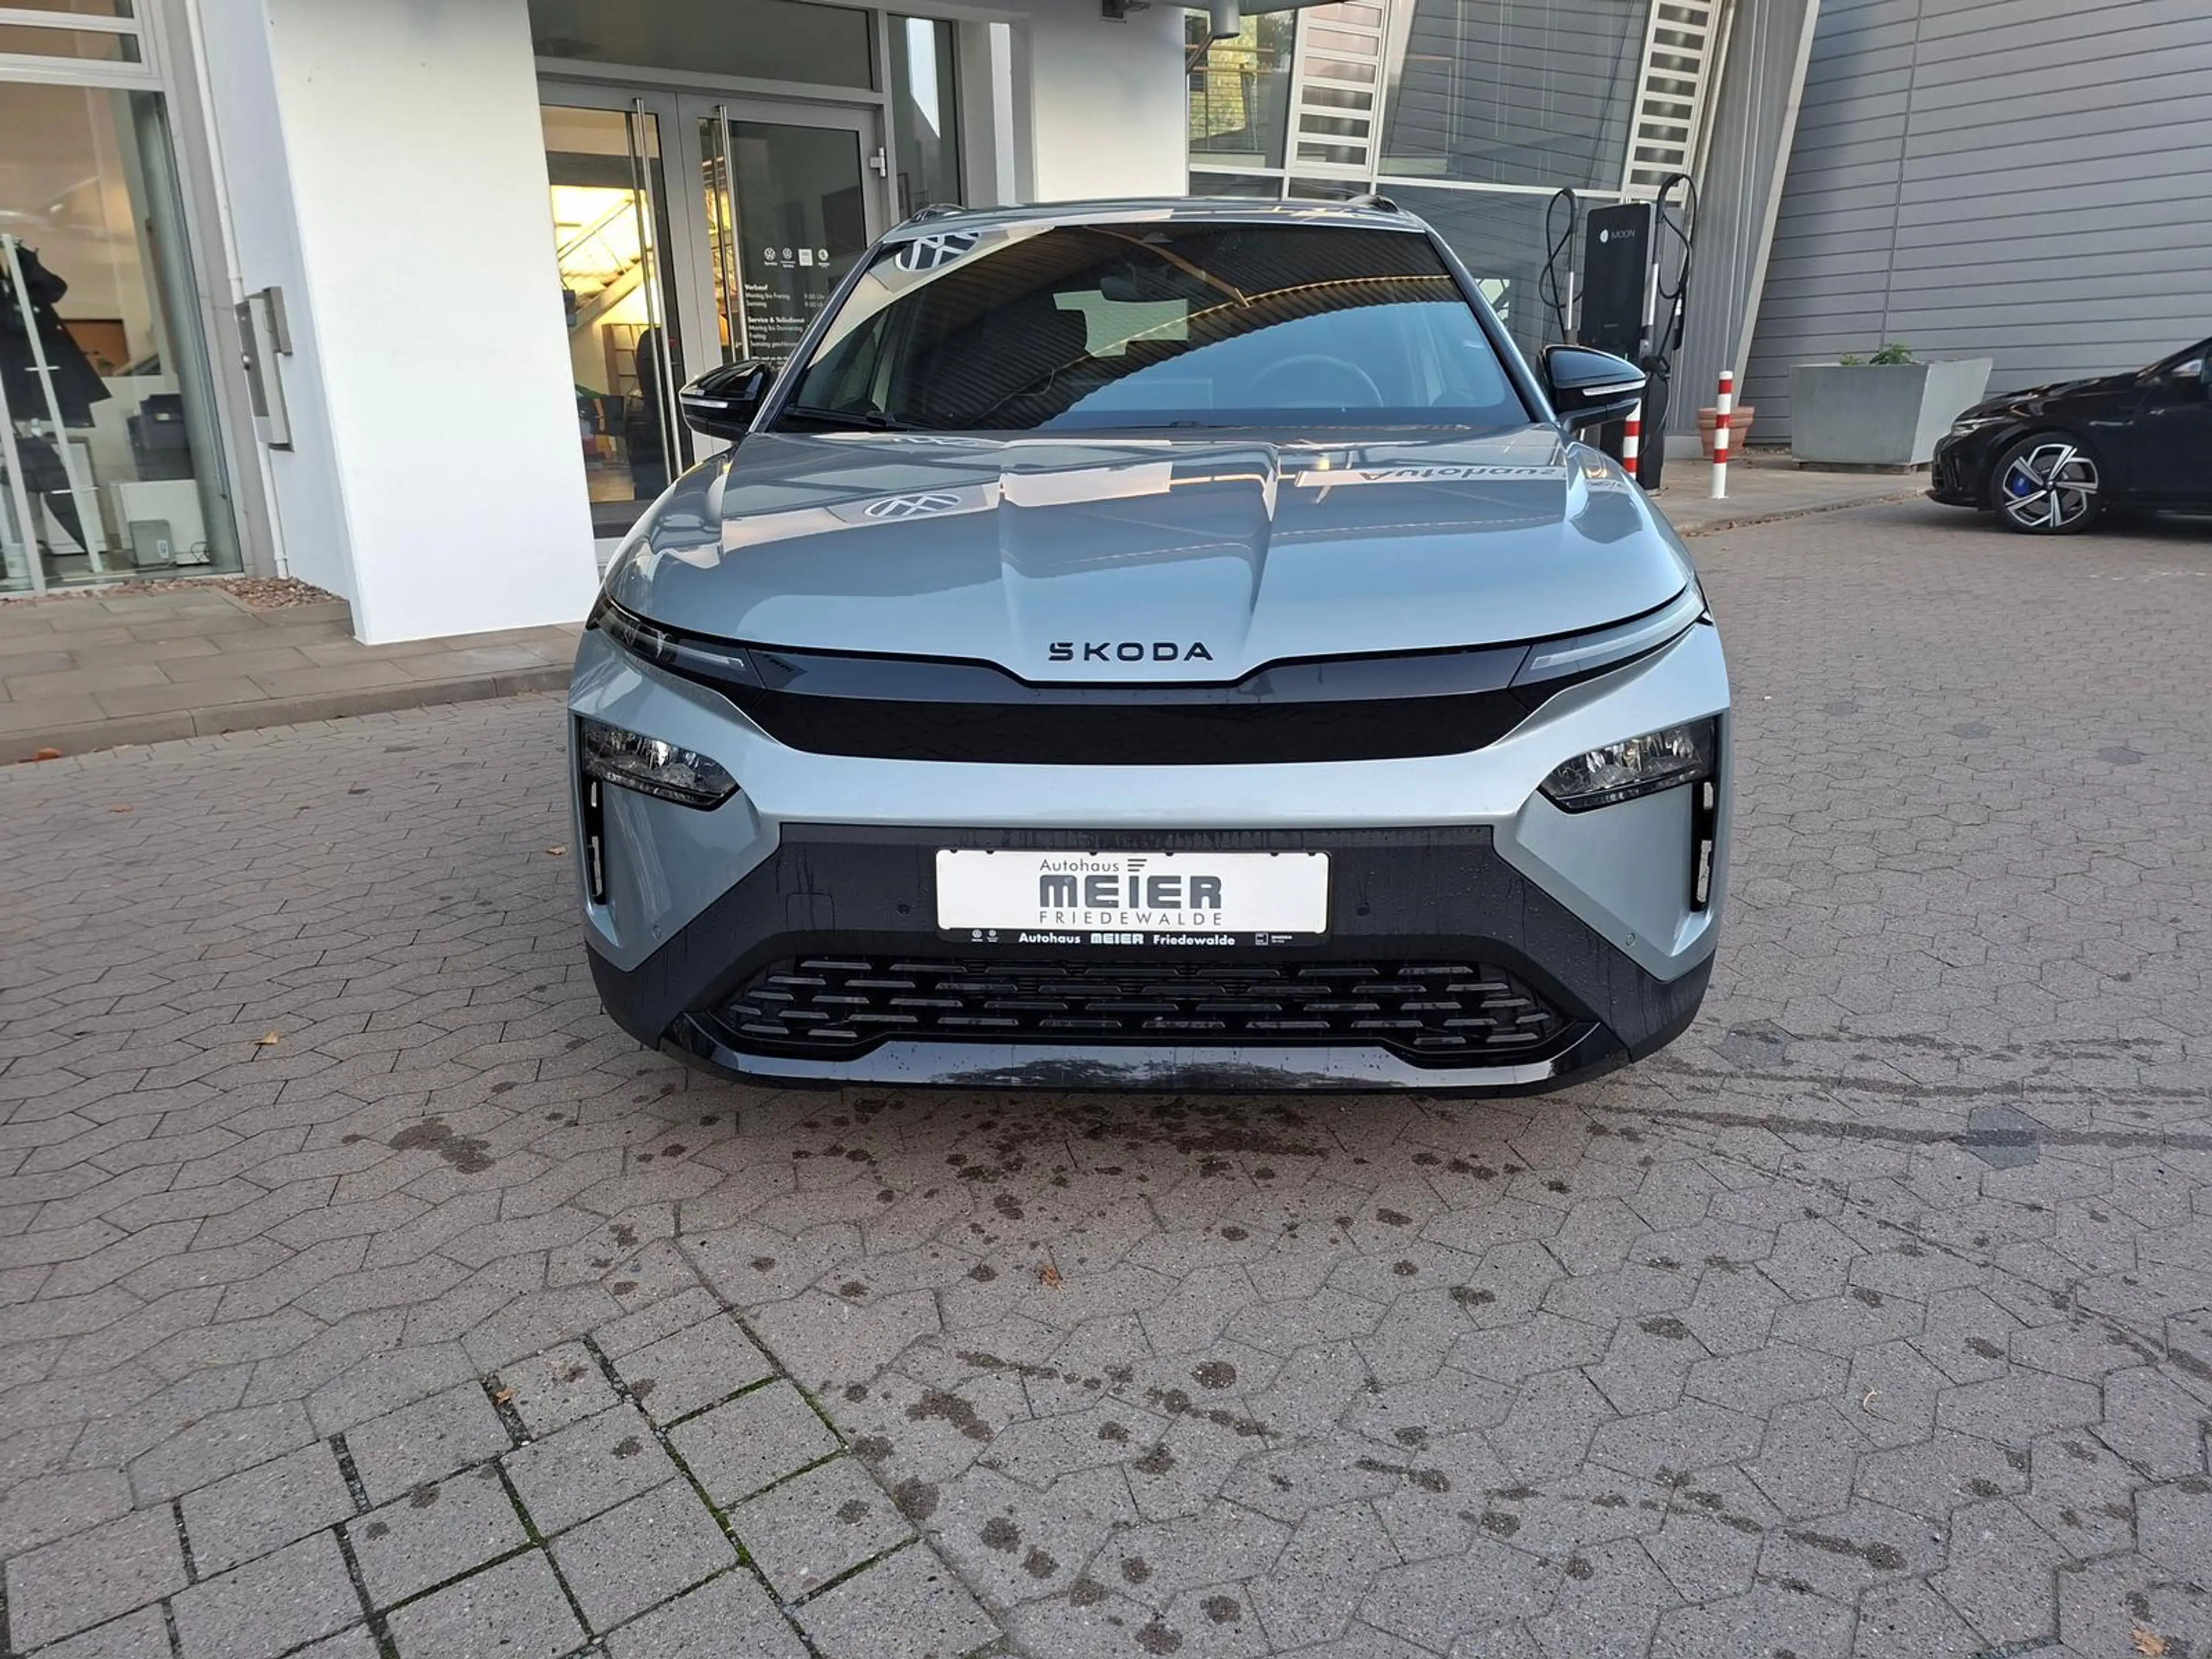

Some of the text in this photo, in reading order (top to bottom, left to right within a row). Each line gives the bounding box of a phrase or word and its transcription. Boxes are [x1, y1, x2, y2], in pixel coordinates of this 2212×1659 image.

[1611, 229, 1636, 240] MOON
[1048, 642, 1214, 661] SKODA
[1039, 859, 1119, 872] Autohaus
[1039, 874, 1222, 909] MEIER
[1039, 911, 1222, 926] FRIEDEWALDE
[1018, 932, 1236, 946] Autohaus MEIER Friedewalde
